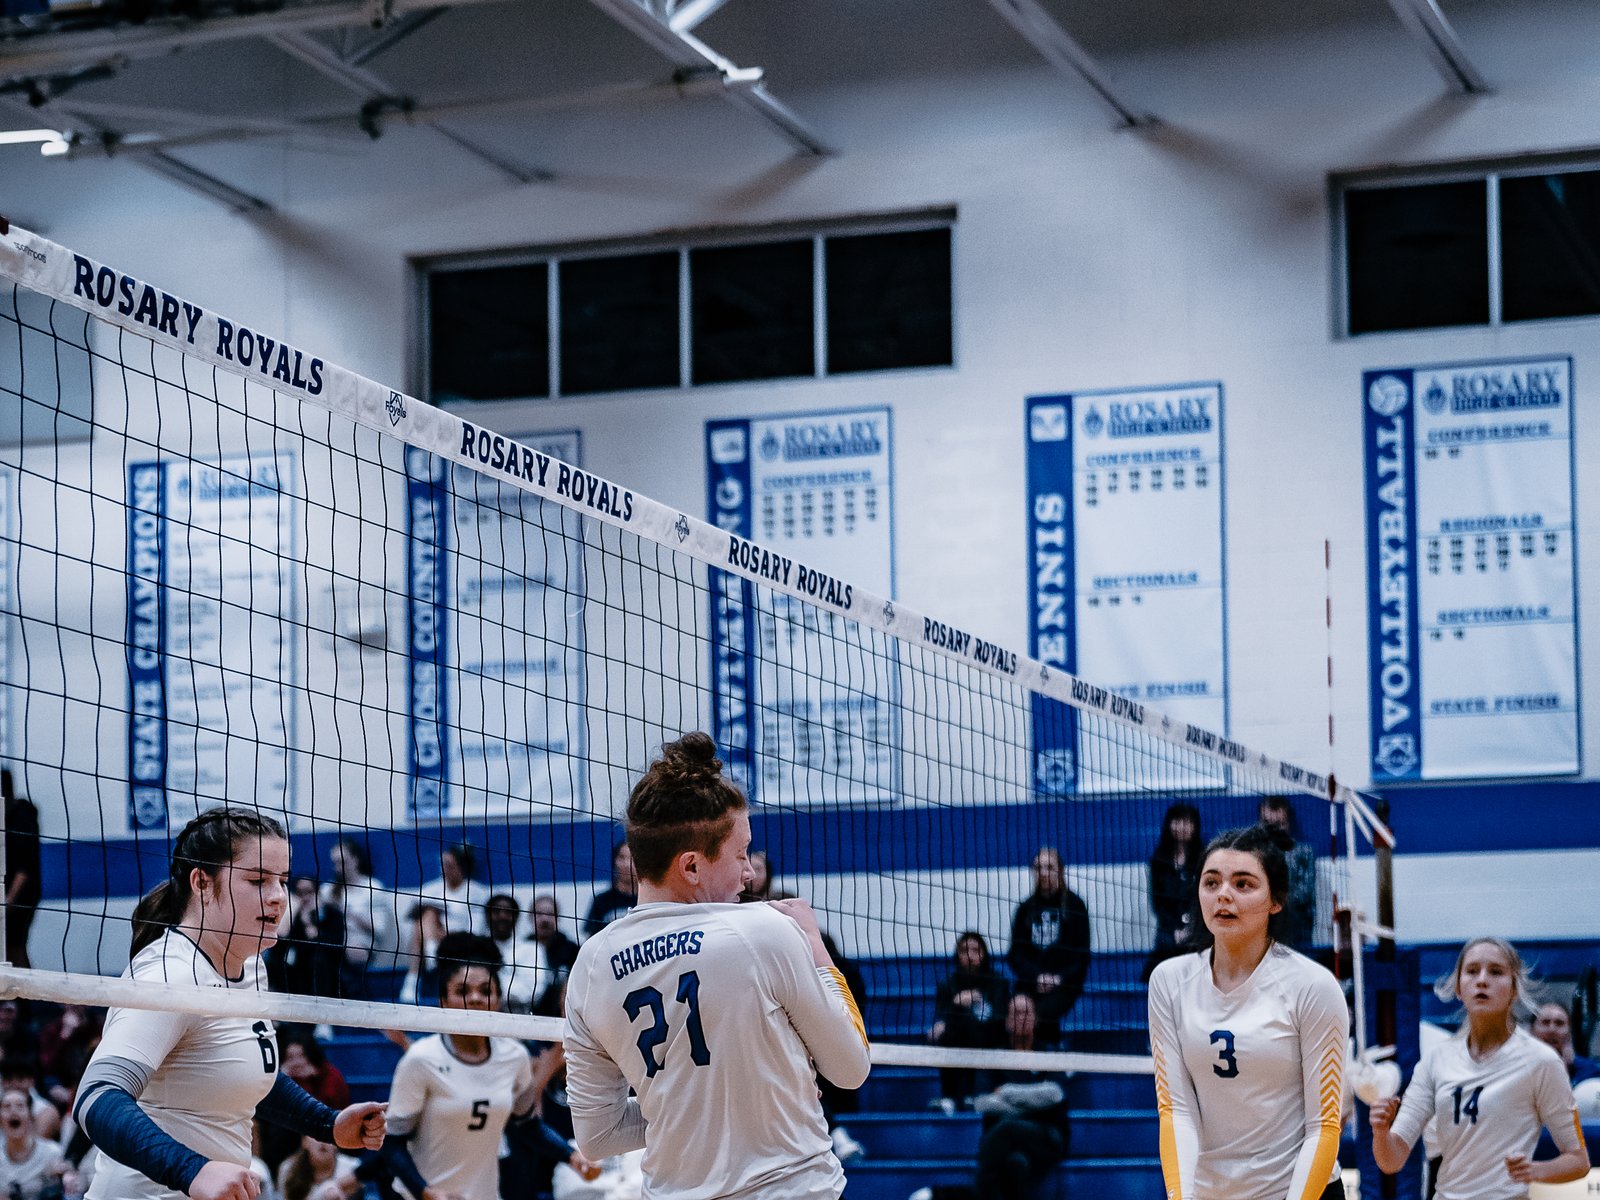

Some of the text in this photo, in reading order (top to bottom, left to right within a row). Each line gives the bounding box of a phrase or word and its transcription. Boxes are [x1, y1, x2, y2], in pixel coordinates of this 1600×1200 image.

[73, 254, 324, 395] ROSARY ROYALS
[385, 400, 407, 419] Royals
[1452, 368, 1558, 398] ROSARY
[461, 422, 633, 522] ROSARY ROYALS
[728, 535, 853, 610] ROSARY ROYALS
[1035, 494, 1067, 697] ENNIS
[1377, 415, 1410, 732] VOLLEYBALL
[924, 617, 1016, 675] ROSARY ROYALS
[1071, 678, 1144, 725] ROSARY ROYALS
[610, 930, 704, 981] CHARGERS
[252, 1020, 277, 1073] 6
[622, 970, 710, 1079] 21
[1209, 1029, 1239, 1078] 3
[468, 1100, 489, 1131] 5
[1451, 1086, 1484, 1125] 14
